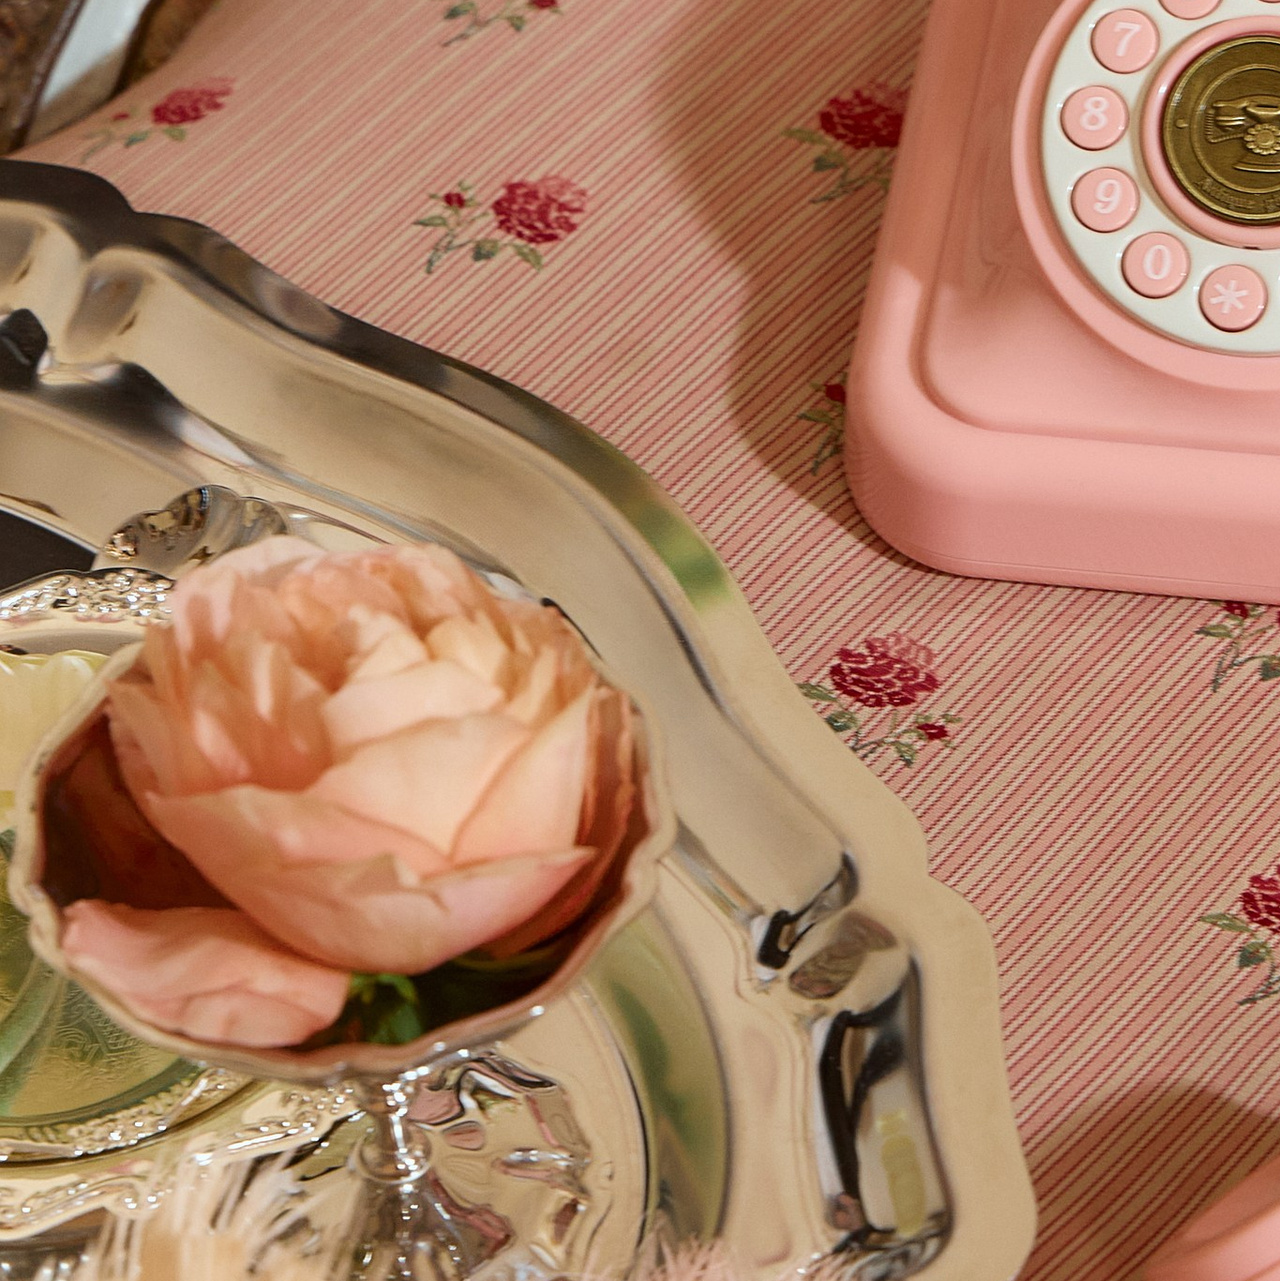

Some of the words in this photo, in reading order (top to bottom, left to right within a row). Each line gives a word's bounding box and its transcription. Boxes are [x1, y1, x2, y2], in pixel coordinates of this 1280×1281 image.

[1113, 21, 1142, 57] 7
[1081, 96, 1109, 131] 8
[1093, 179, 1122, 214] 9
